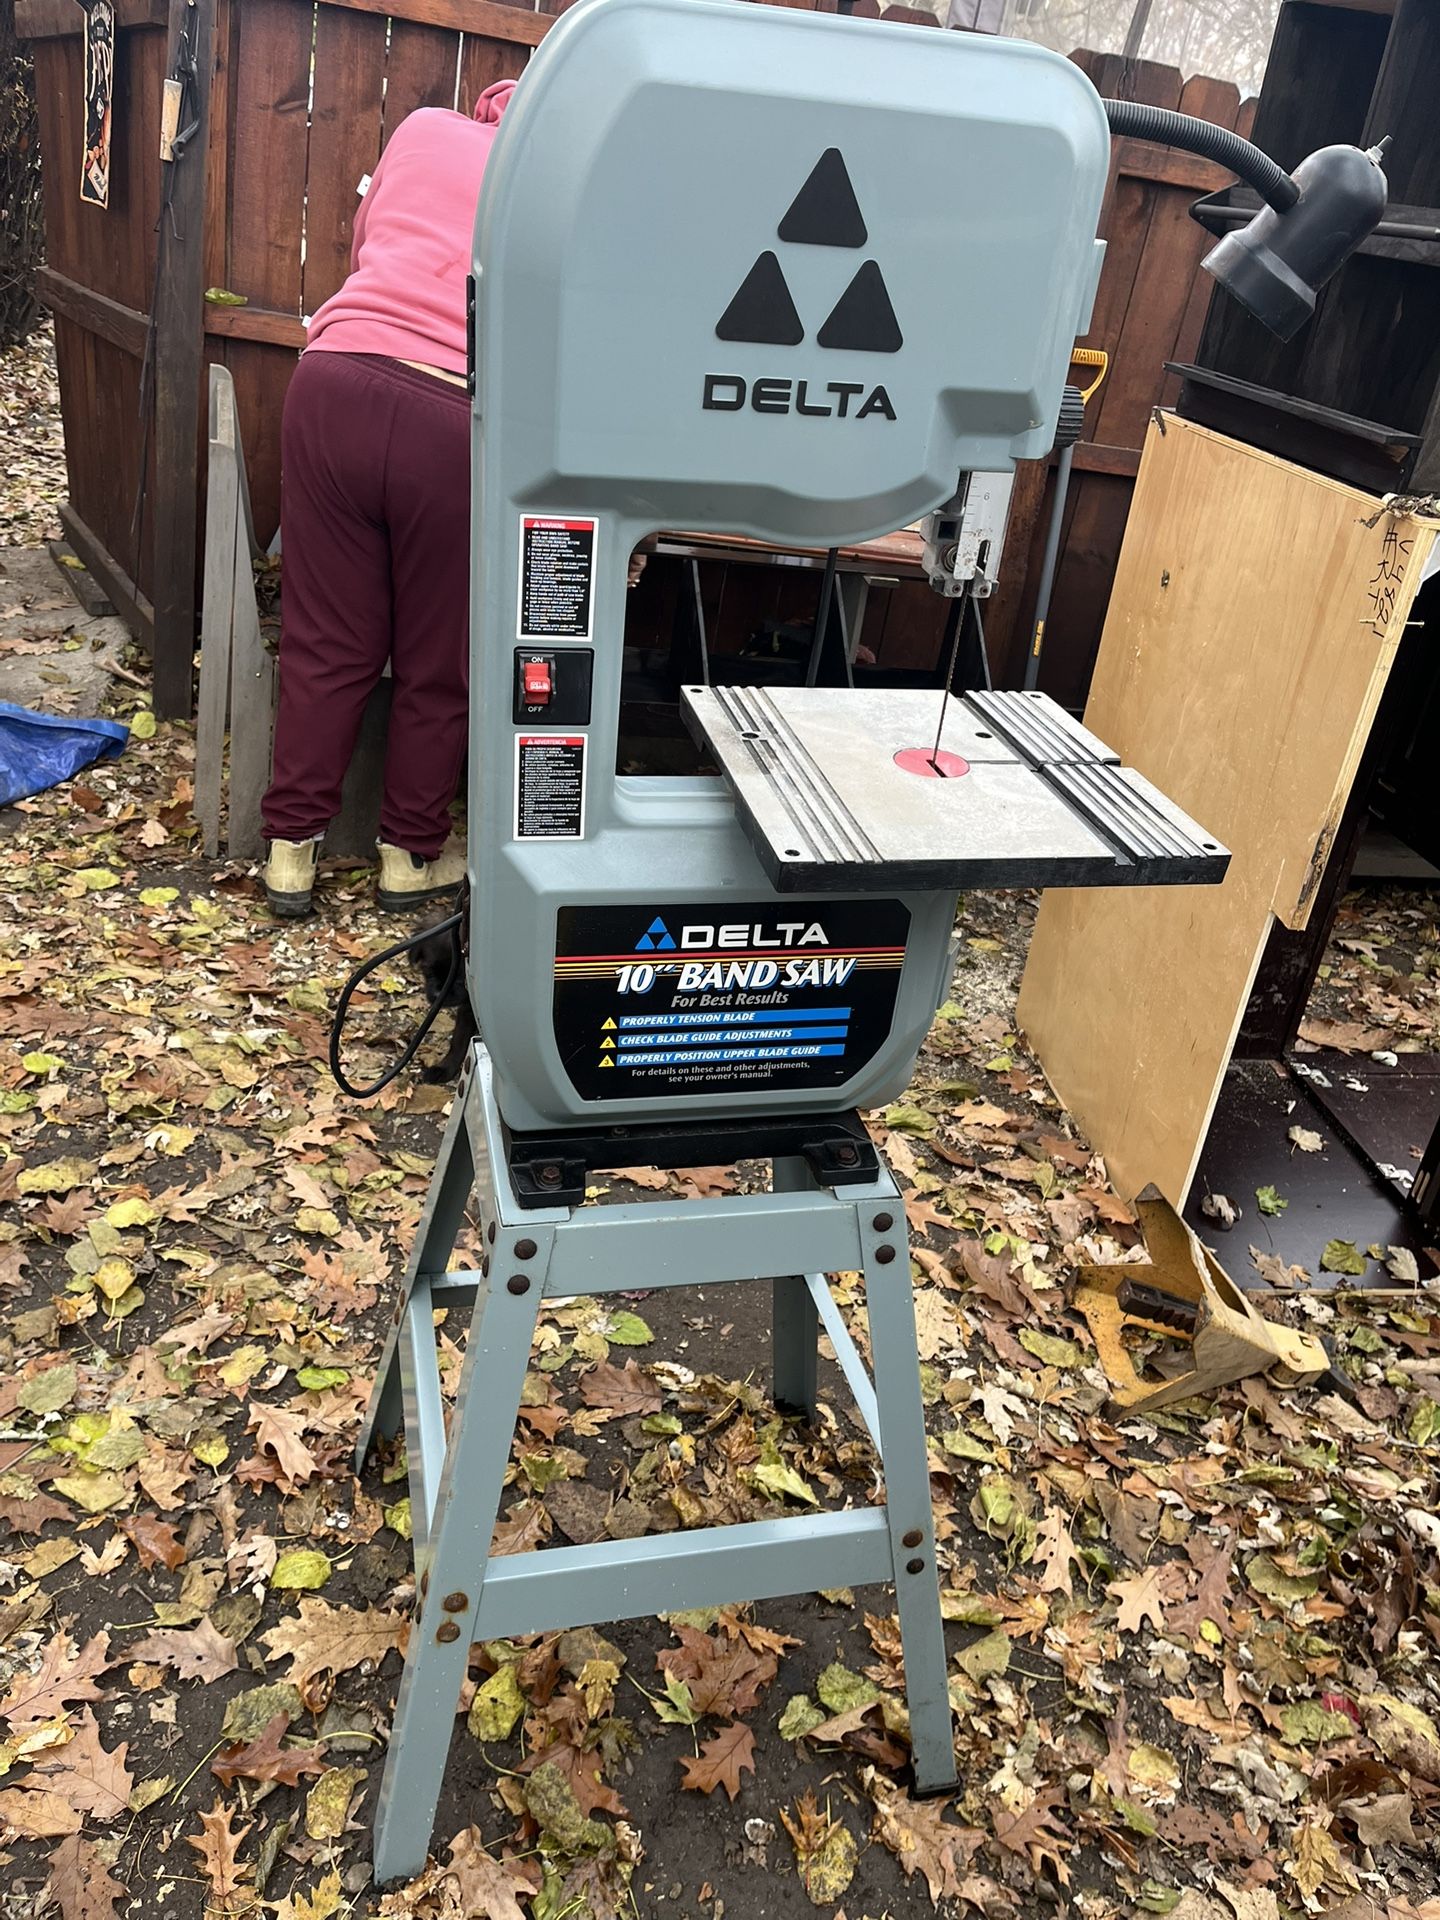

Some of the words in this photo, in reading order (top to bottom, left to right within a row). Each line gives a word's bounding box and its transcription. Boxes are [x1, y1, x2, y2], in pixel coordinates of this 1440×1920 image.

[702, 372, 897, 420] DELTA
[540, 521, 566, 529] WARNING
[681, 922, 829, 949] DELTA
[676, 960, 781, 993] BAND
[780, 957, 857, 989] SAW
[671, 995, 698, 1008] For
[700, 993, 734, 1007] Best
[735, 991, 789, 1005] Results
[622, 1015, 676, 1026] PROPERLY
[678, 1013, 721, 1024] TENSION
[723, 1012, 756, 1022] BLADE
[621, 1035, 655, 1045] CHECK
[656, 1034, 689, 1044] BLADE
[690, 1032, 723, 1042] GUIDE
[723, 1029, 793, 1041] ADJUSTMENTS
[619, 1053, 673, 1064] PROPERLY
[673, 1050, 722, 1061] POSITION
[723, 1049, 757, 1059] UPPER
[758, 1047, 789, 1057] BLADE
[790, 1046, 821, 1055] GUIDE
[631, 1069, 645, 1077] For
[648, 1067, 676, 1076] details
[691, 1065, 714, 1073] these
[715, 1064, 732, 1073] and
[733, 1062, 756, 1071] other
[758, 1061, 811, 1072] adjustments,
[684, 1074, 703, 1083] your
[705, 1072, 738, 1081] owner's
[739, 1070, 773, 1079] manual.
